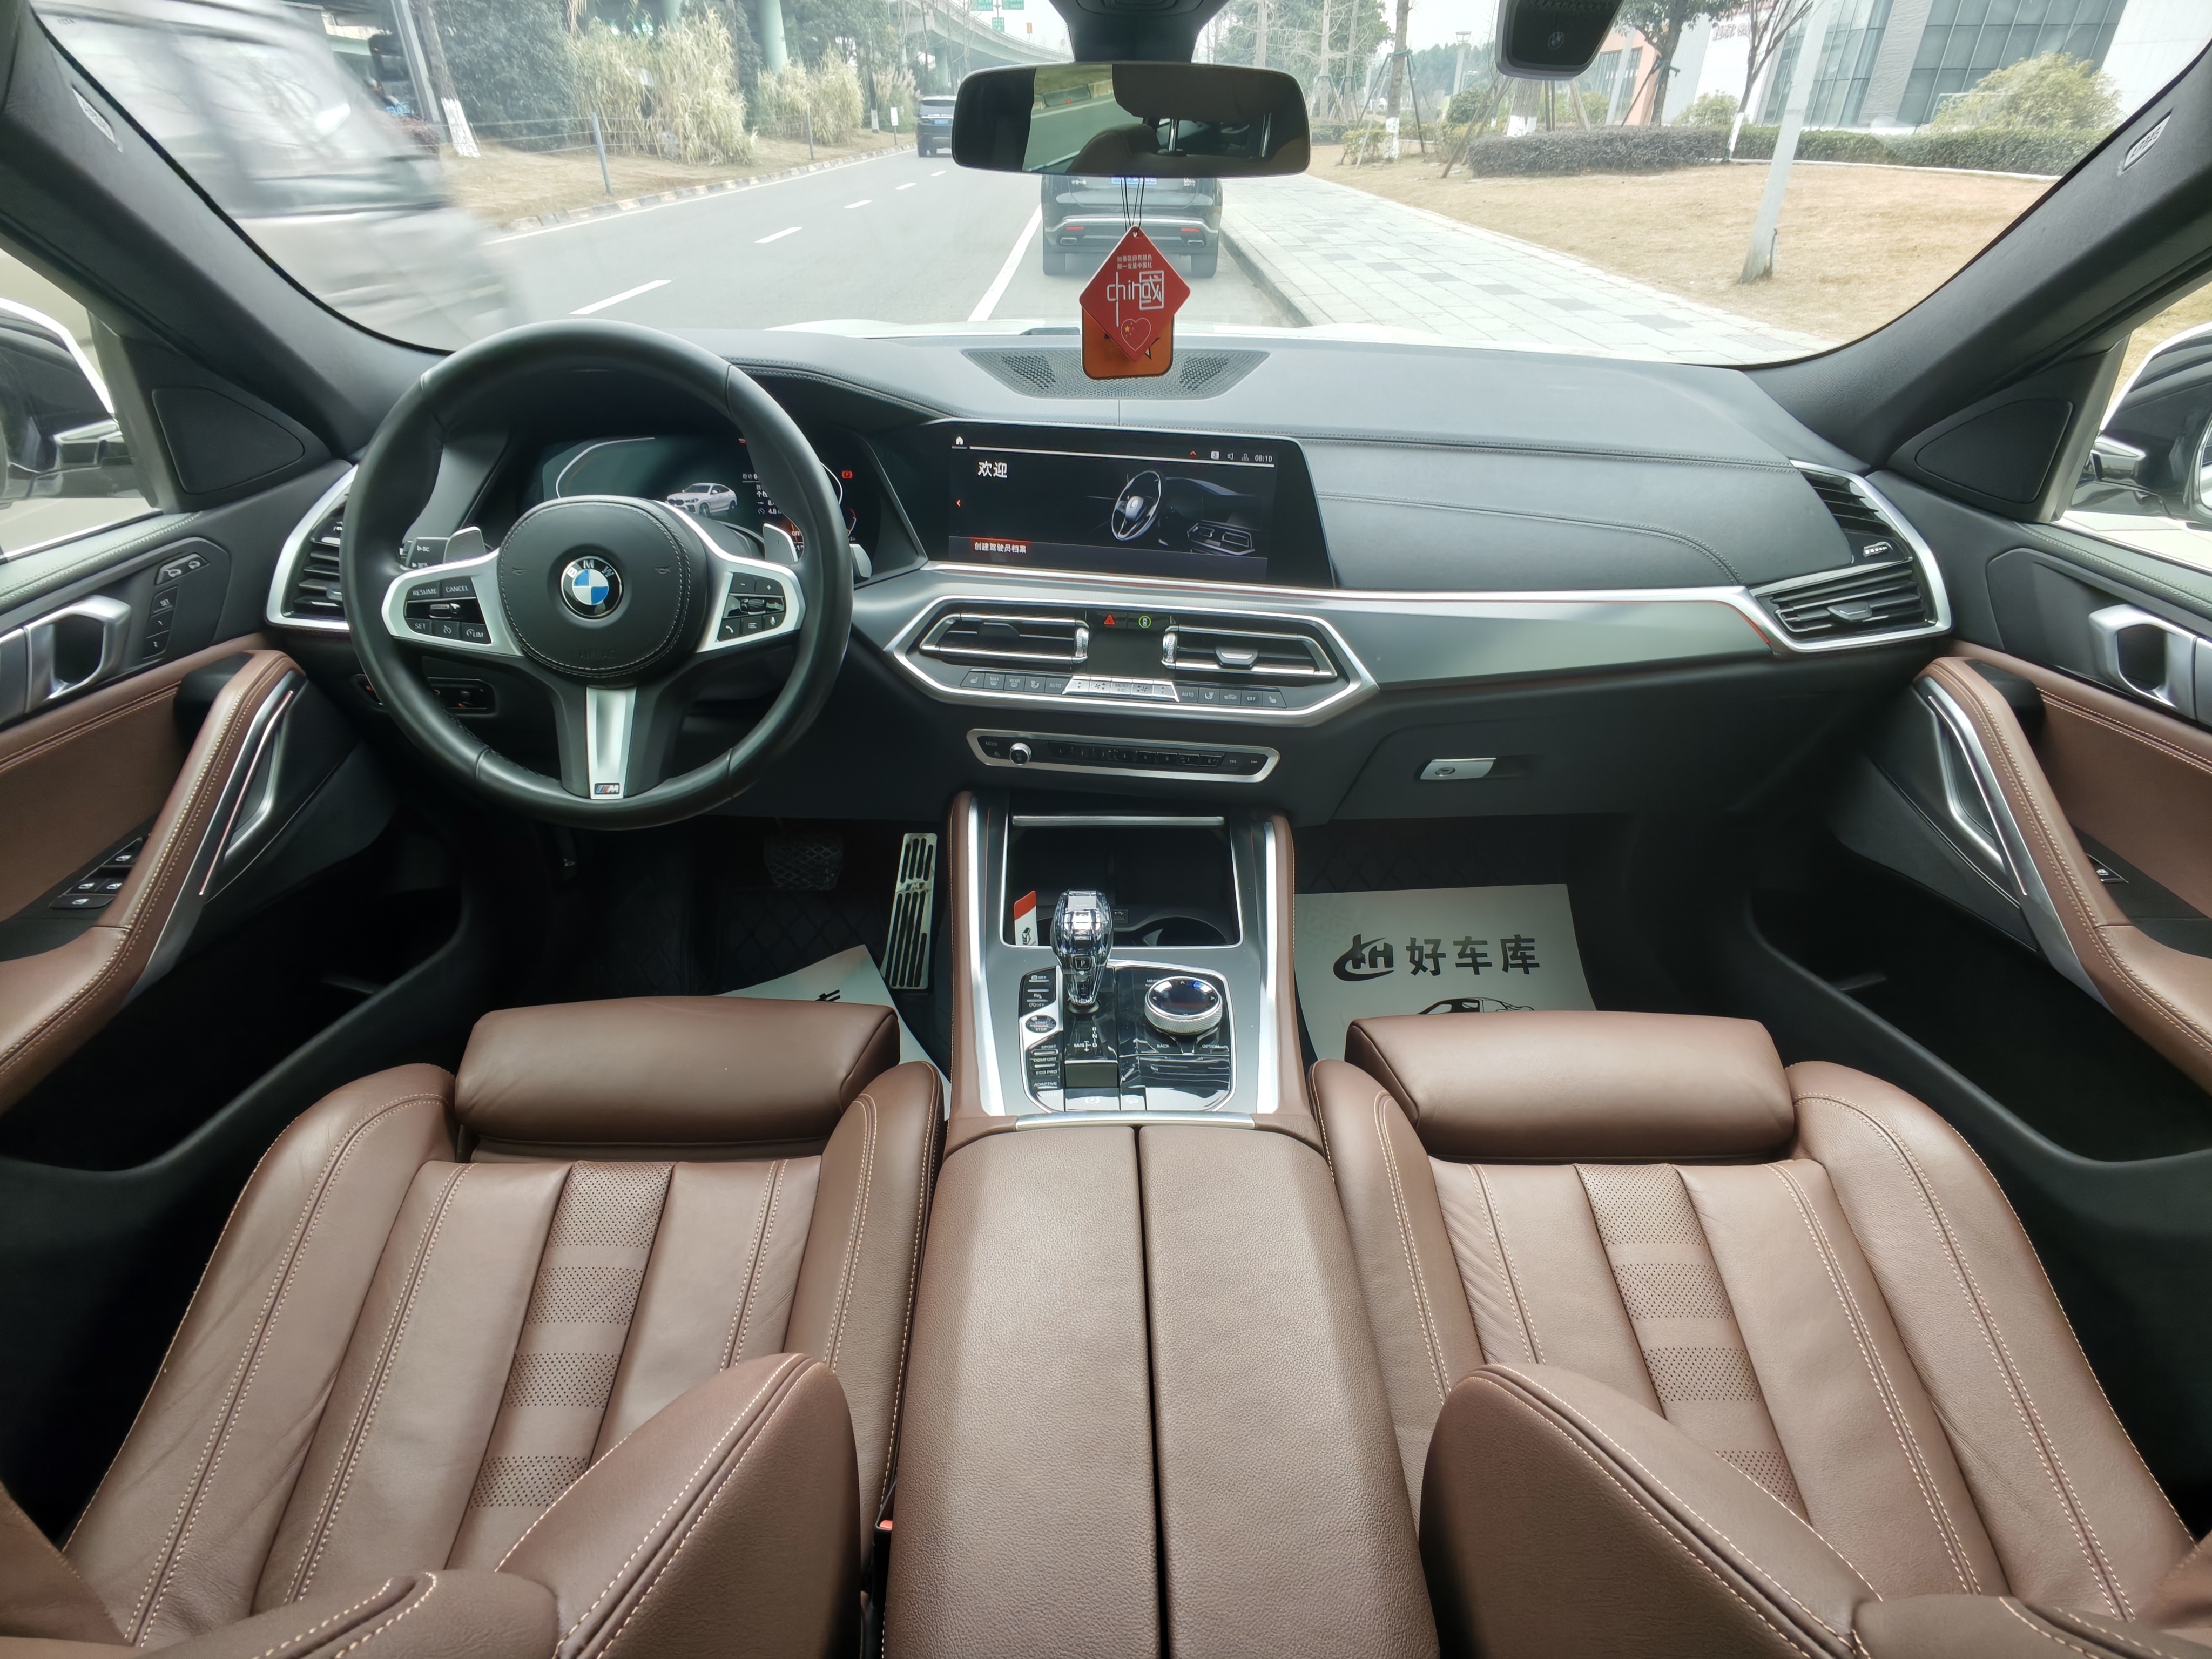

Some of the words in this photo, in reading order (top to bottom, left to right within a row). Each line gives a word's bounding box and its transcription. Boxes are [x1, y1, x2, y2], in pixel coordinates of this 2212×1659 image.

[977, 460, 1008, 478] 欢迎
[974, 542, 1027, 554] 创建驾驶员档案
[412, 588, 437, 596] RESUME
[1406, 934, 1540, 976] 好车库
